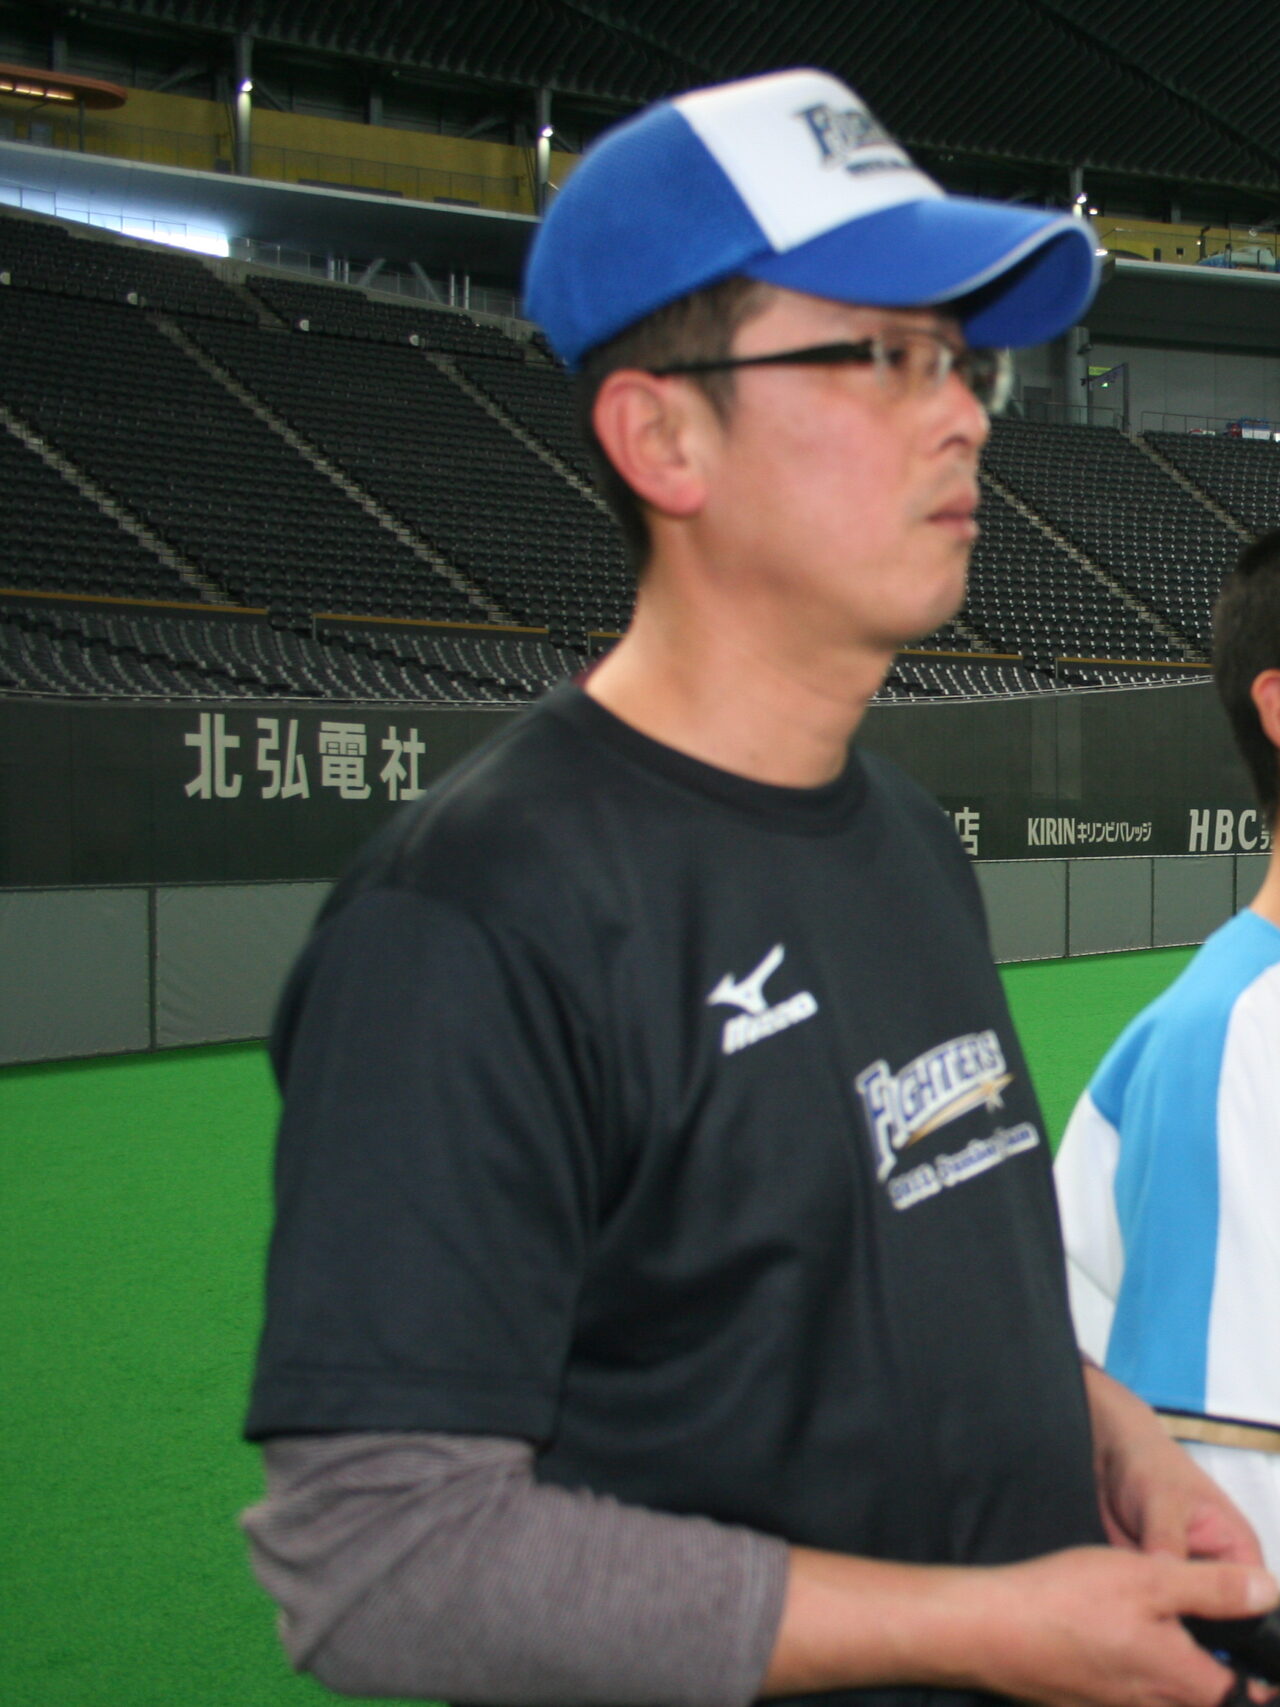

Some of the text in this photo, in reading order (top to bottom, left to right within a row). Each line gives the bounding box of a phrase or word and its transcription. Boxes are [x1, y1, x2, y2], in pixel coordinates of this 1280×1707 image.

[184, 712, 428, 801] 北弘電社
[1027, 817, 1153, 846] KIRIN キリンビバレッジ
[1188, 808, 1258, 852] HBC
